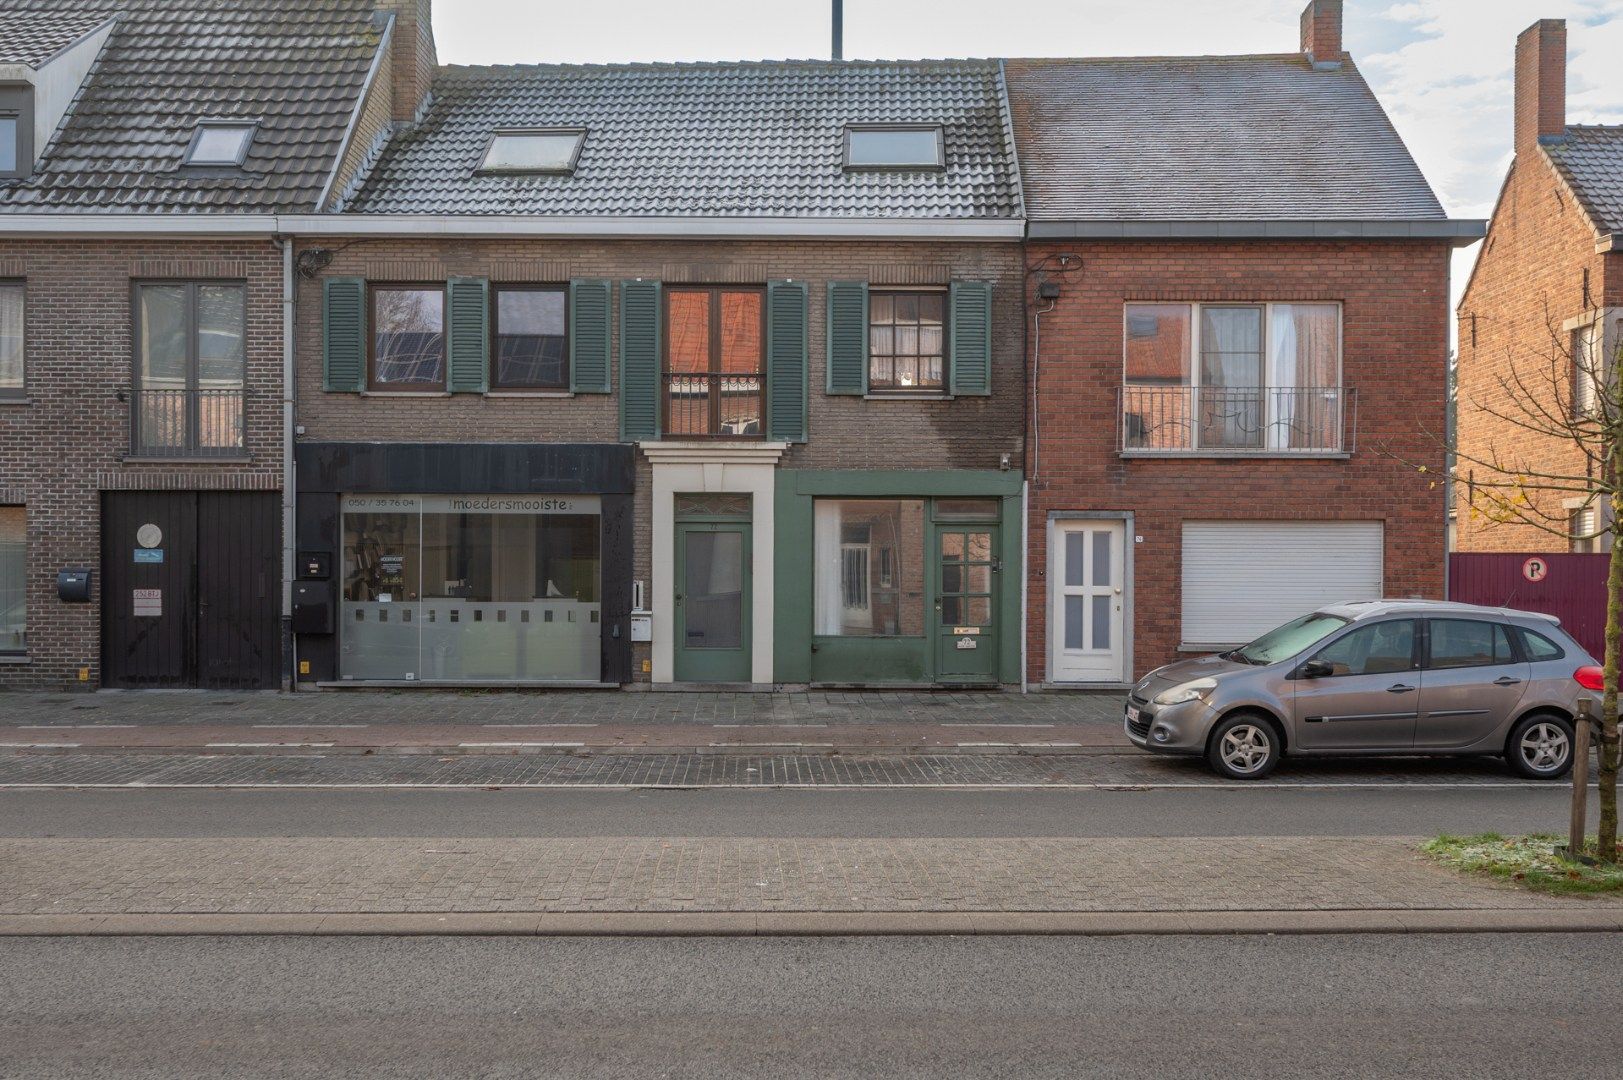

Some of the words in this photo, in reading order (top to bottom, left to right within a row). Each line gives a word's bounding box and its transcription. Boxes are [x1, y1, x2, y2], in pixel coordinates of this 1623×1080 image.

[348, 499, 366, 507] 050
[402, 499, 414, 507] 04
[1530, 562, 1541, 577] P
